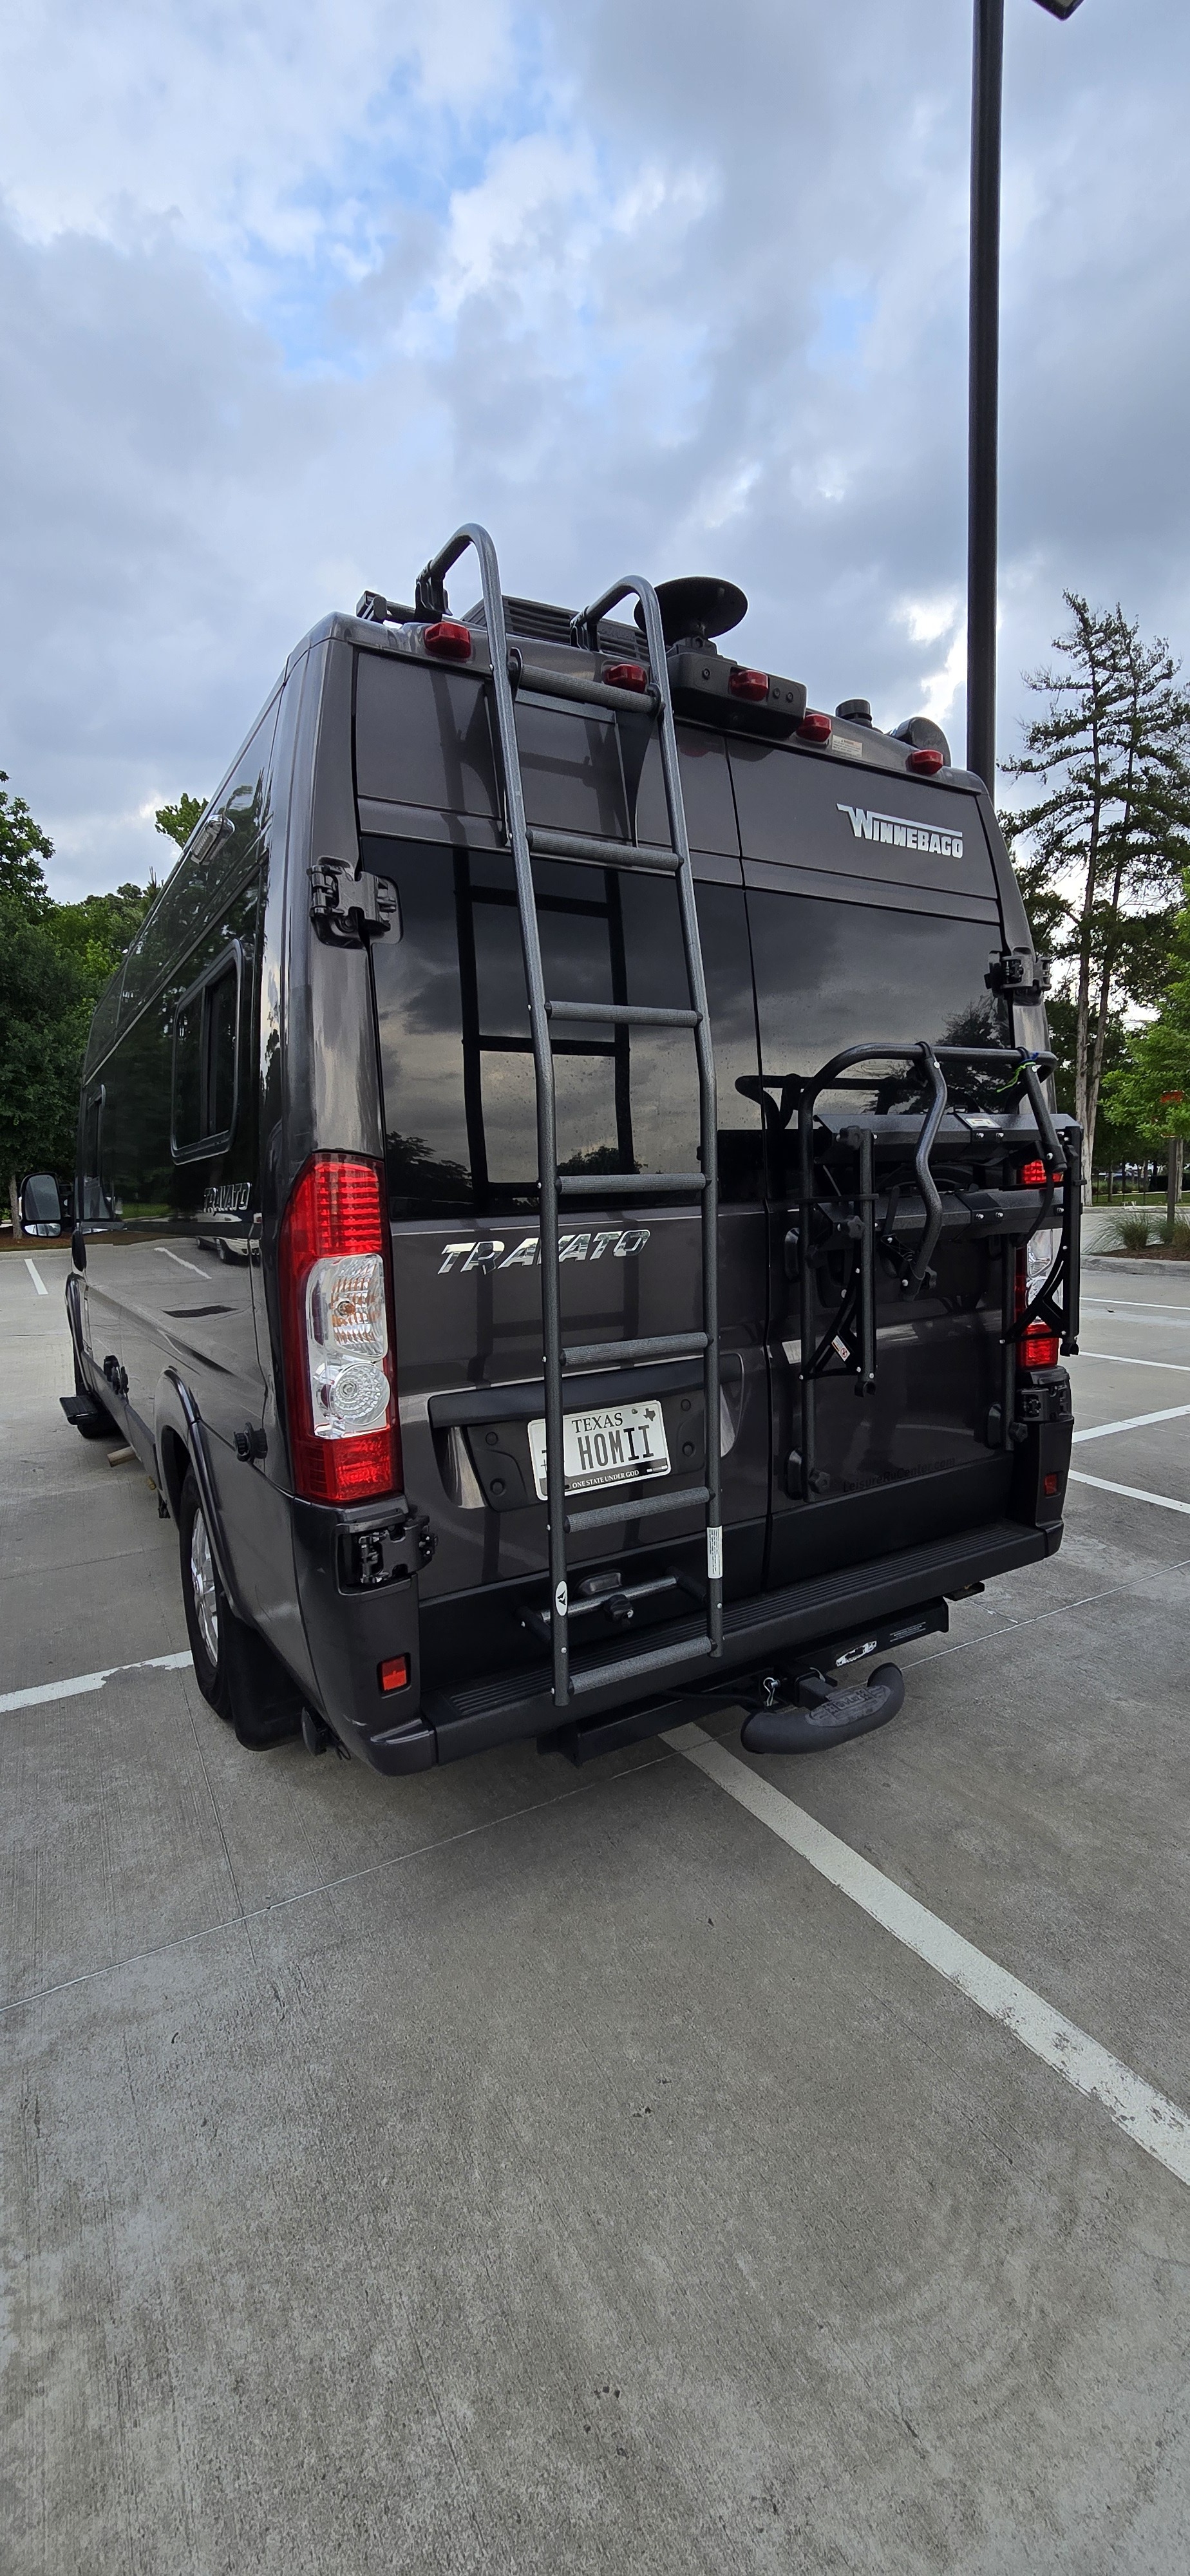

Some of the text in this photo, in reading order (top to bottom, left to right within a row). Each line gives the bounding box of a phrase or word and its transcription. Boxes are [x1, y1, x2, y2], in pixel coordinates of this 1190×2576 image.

[203, 1182, 252, 1213] TRAVATO
[572, 1412, 623, 1434] TEXAS
[577, 1425, 654, 1471] HOMII
[586, 1477, 605, 1485] STATE
[605, 1473, 625, 1482] UNDER
